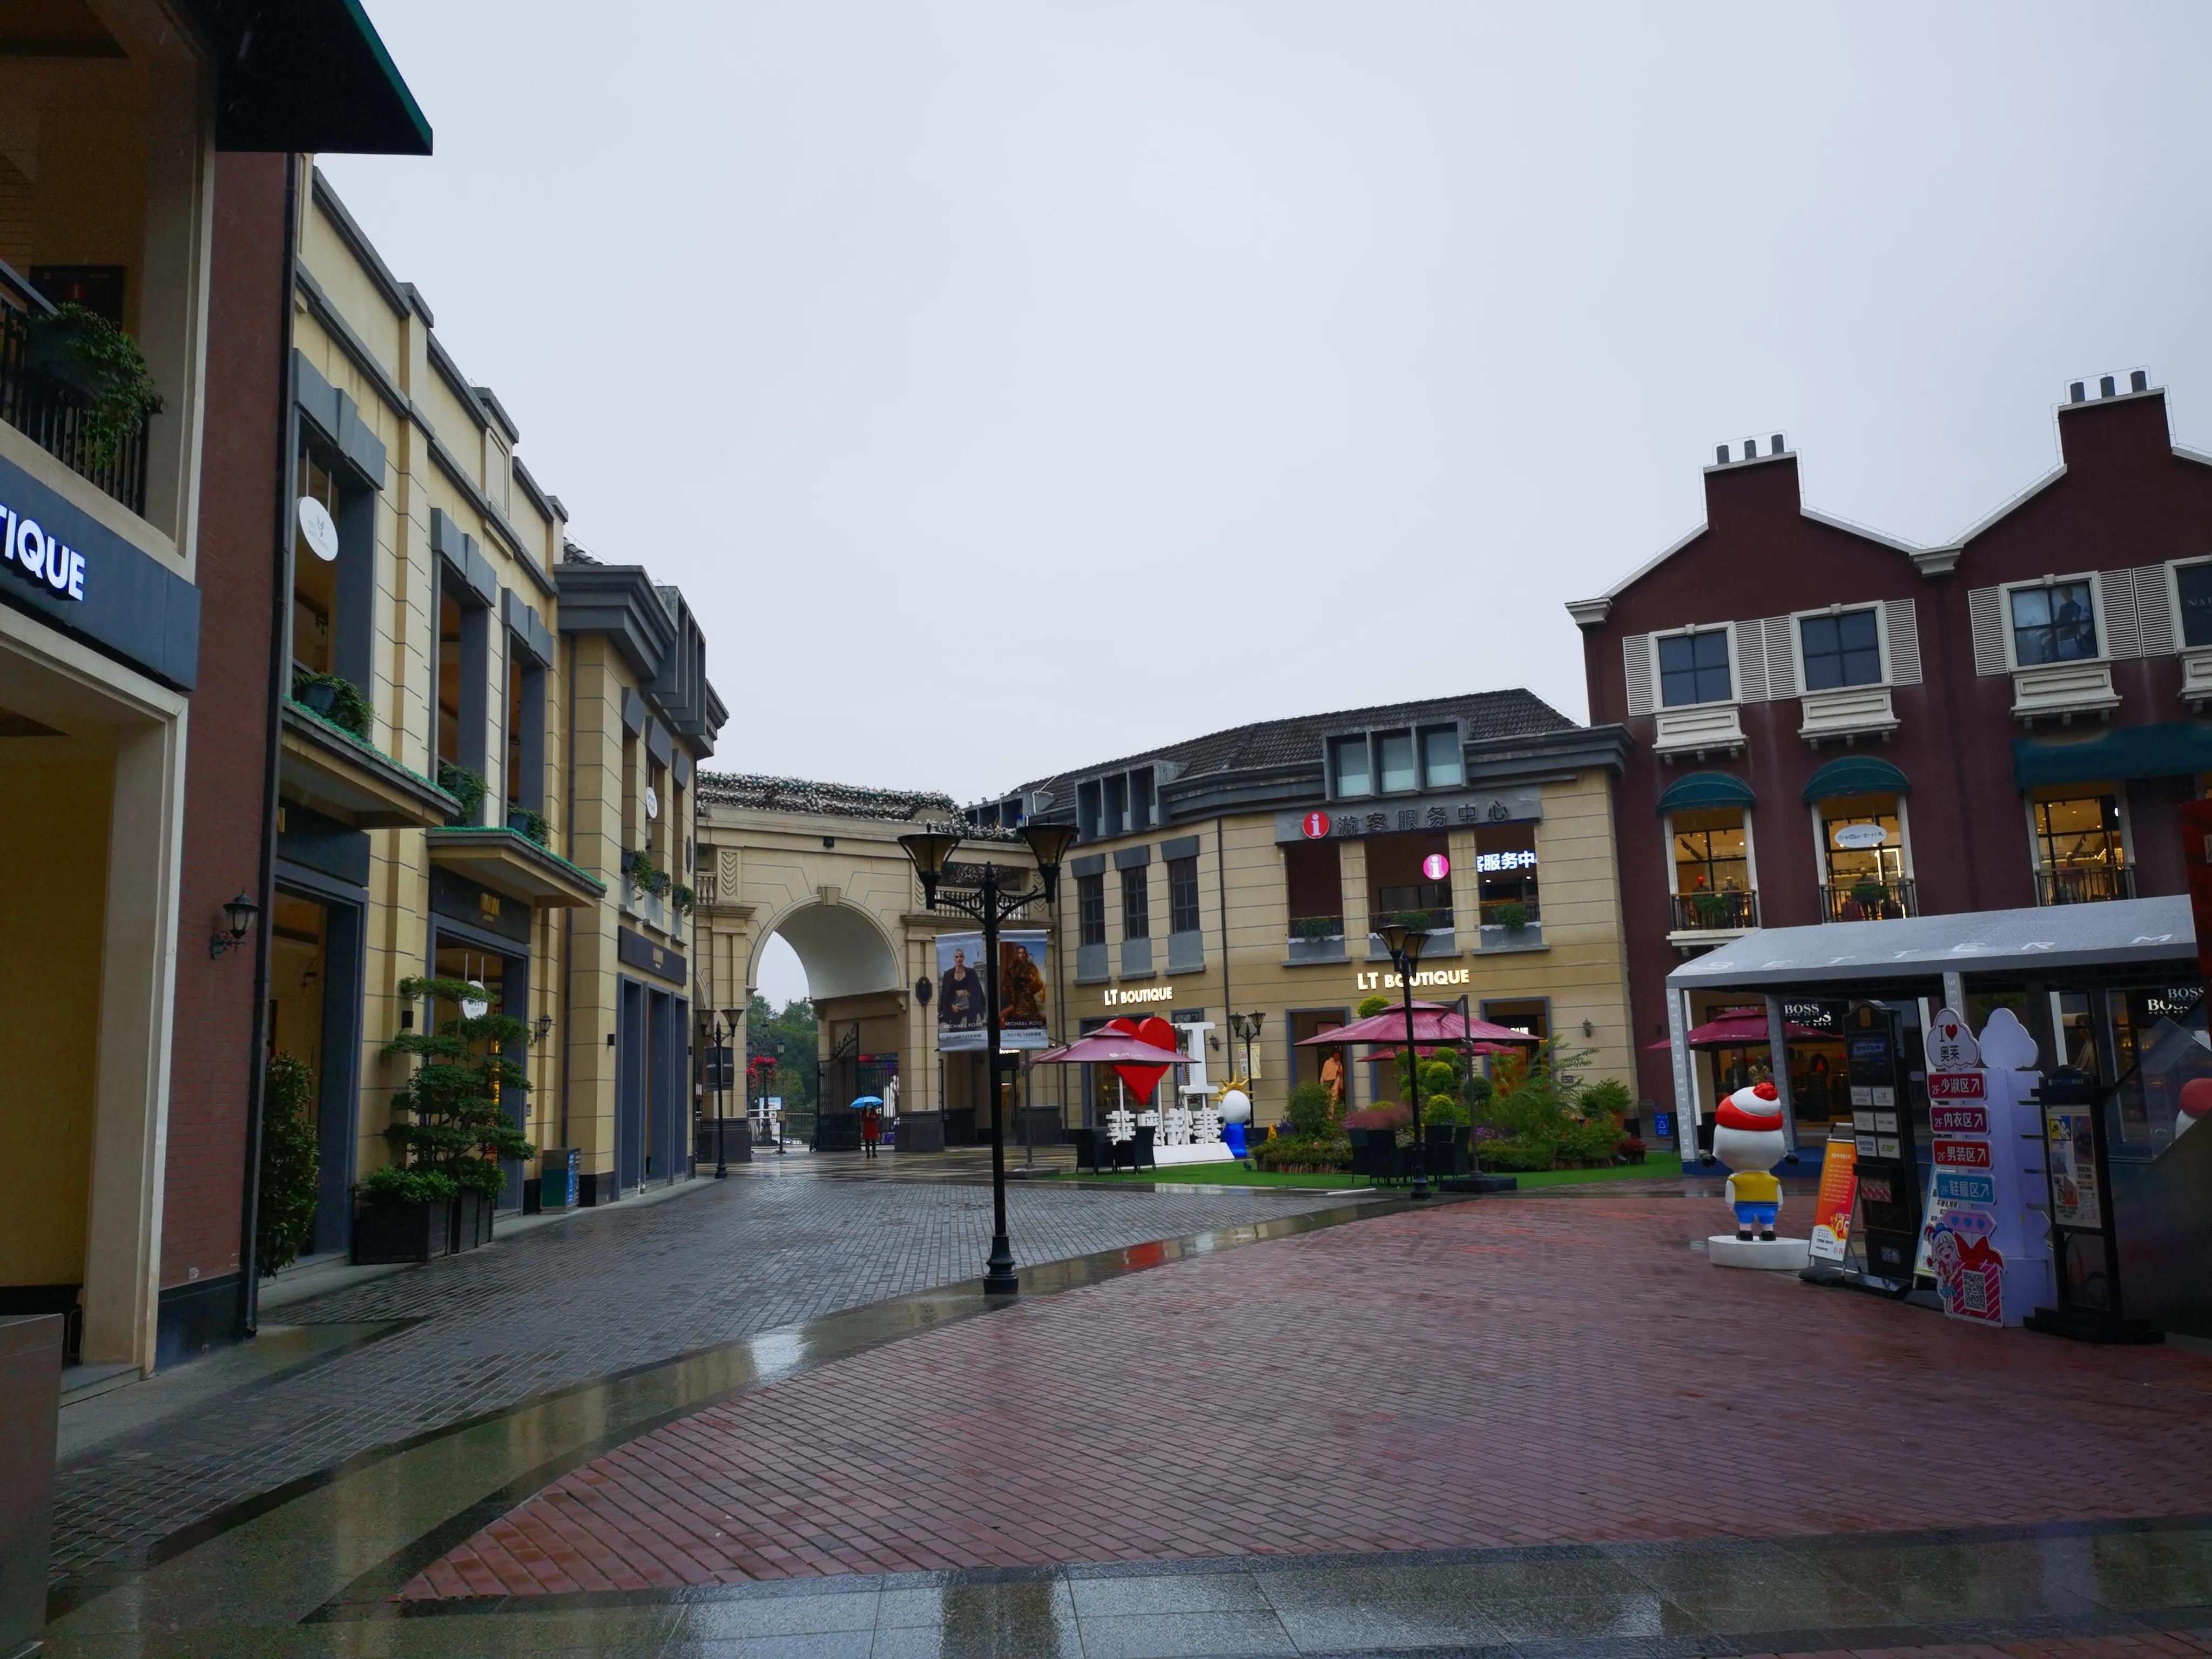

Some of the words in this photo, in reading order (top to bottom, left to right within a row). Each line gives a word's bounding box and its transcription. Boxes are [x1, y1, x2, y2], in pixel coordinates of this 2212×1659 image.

[0, 504, 85, 606] IQUE
[1337, 800, 1508, 836] 游客服务中心
[1476, 851, 1537, 873] 服务中
[1357, 972, 1379, 990] LT
[1104, 989, 1118, 1006] LT
[1121, 987, 1173, 1004] BOUTIQUE
[1784, 1004, 1819, 1014] BOSS
[1940, 1045, 1960, 1062] 奥莱
[1941, 1078, 1970, 1094] 少淑区
[1944, 1112, 1972, 1128] 内衣区
[1947, 1146, 1975, 1162] 男装区
[1949, 1180, 1979, 1197] 鞋履区
